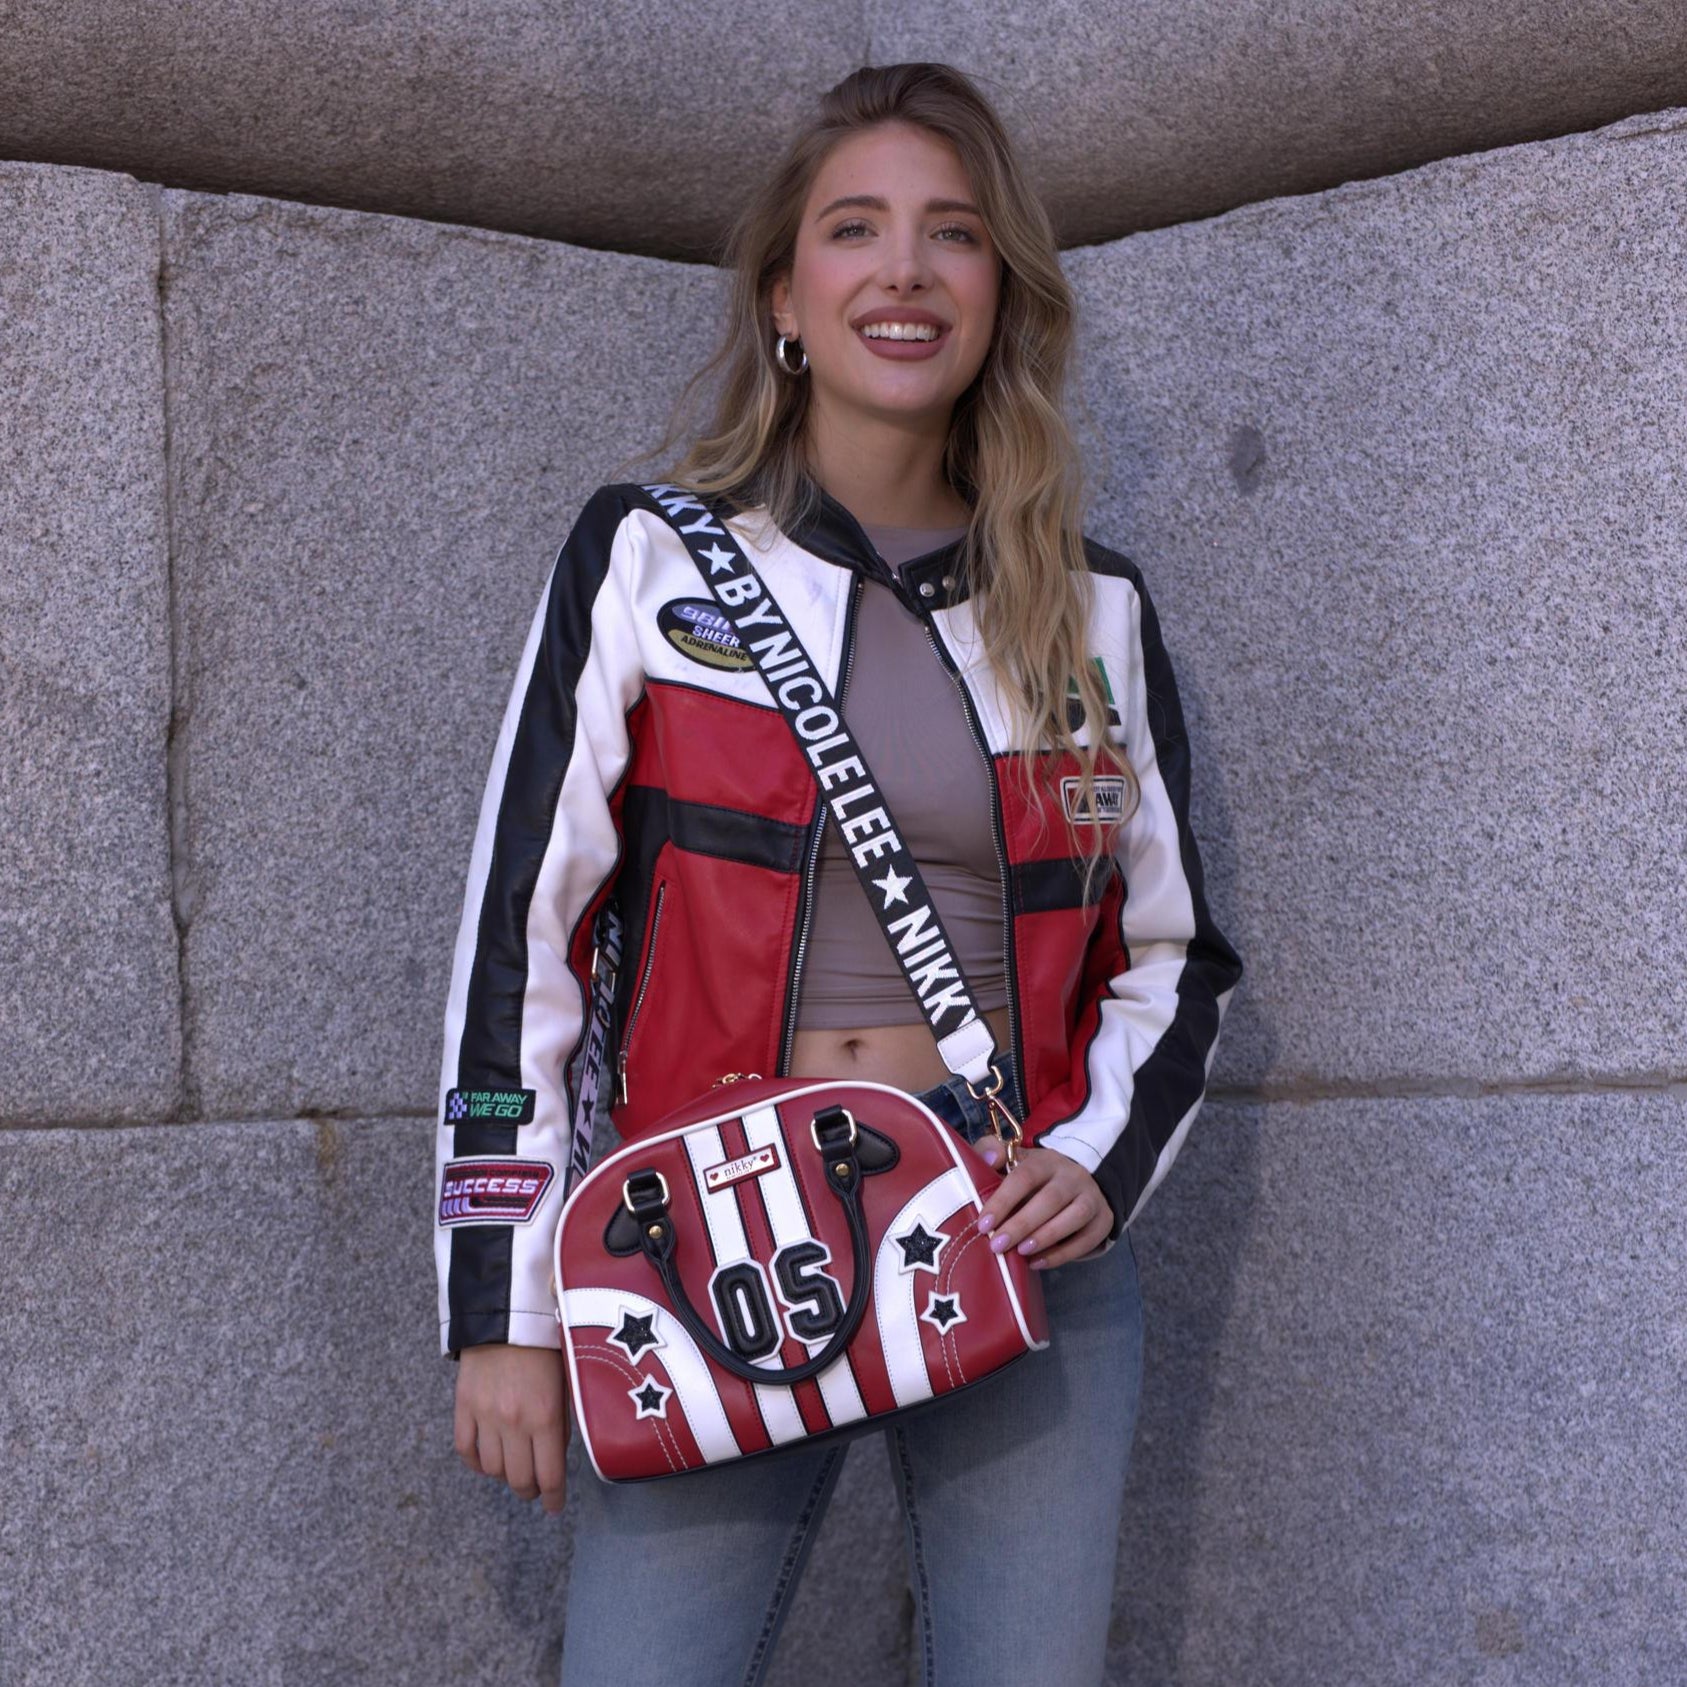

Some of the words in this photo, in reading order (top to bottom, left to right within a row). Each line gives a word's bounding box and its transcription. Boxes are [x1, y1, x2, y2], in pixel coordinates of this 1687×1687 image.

[714, 573, 783, 629] BY
[692, 625, 741, 648] SHEER
[681, 635, 748, 661] ADRENALINE
[470, 1092, 491, 1102] FAR
[492, 1092, 528, 1104] AWAY
[470, 1103, 495, 1118] WE
[494, 1104, 523, 1118] GO
[724, 1159, 754, 1176] nikky
[444, 1178, 539, 1197] SUCCESS
